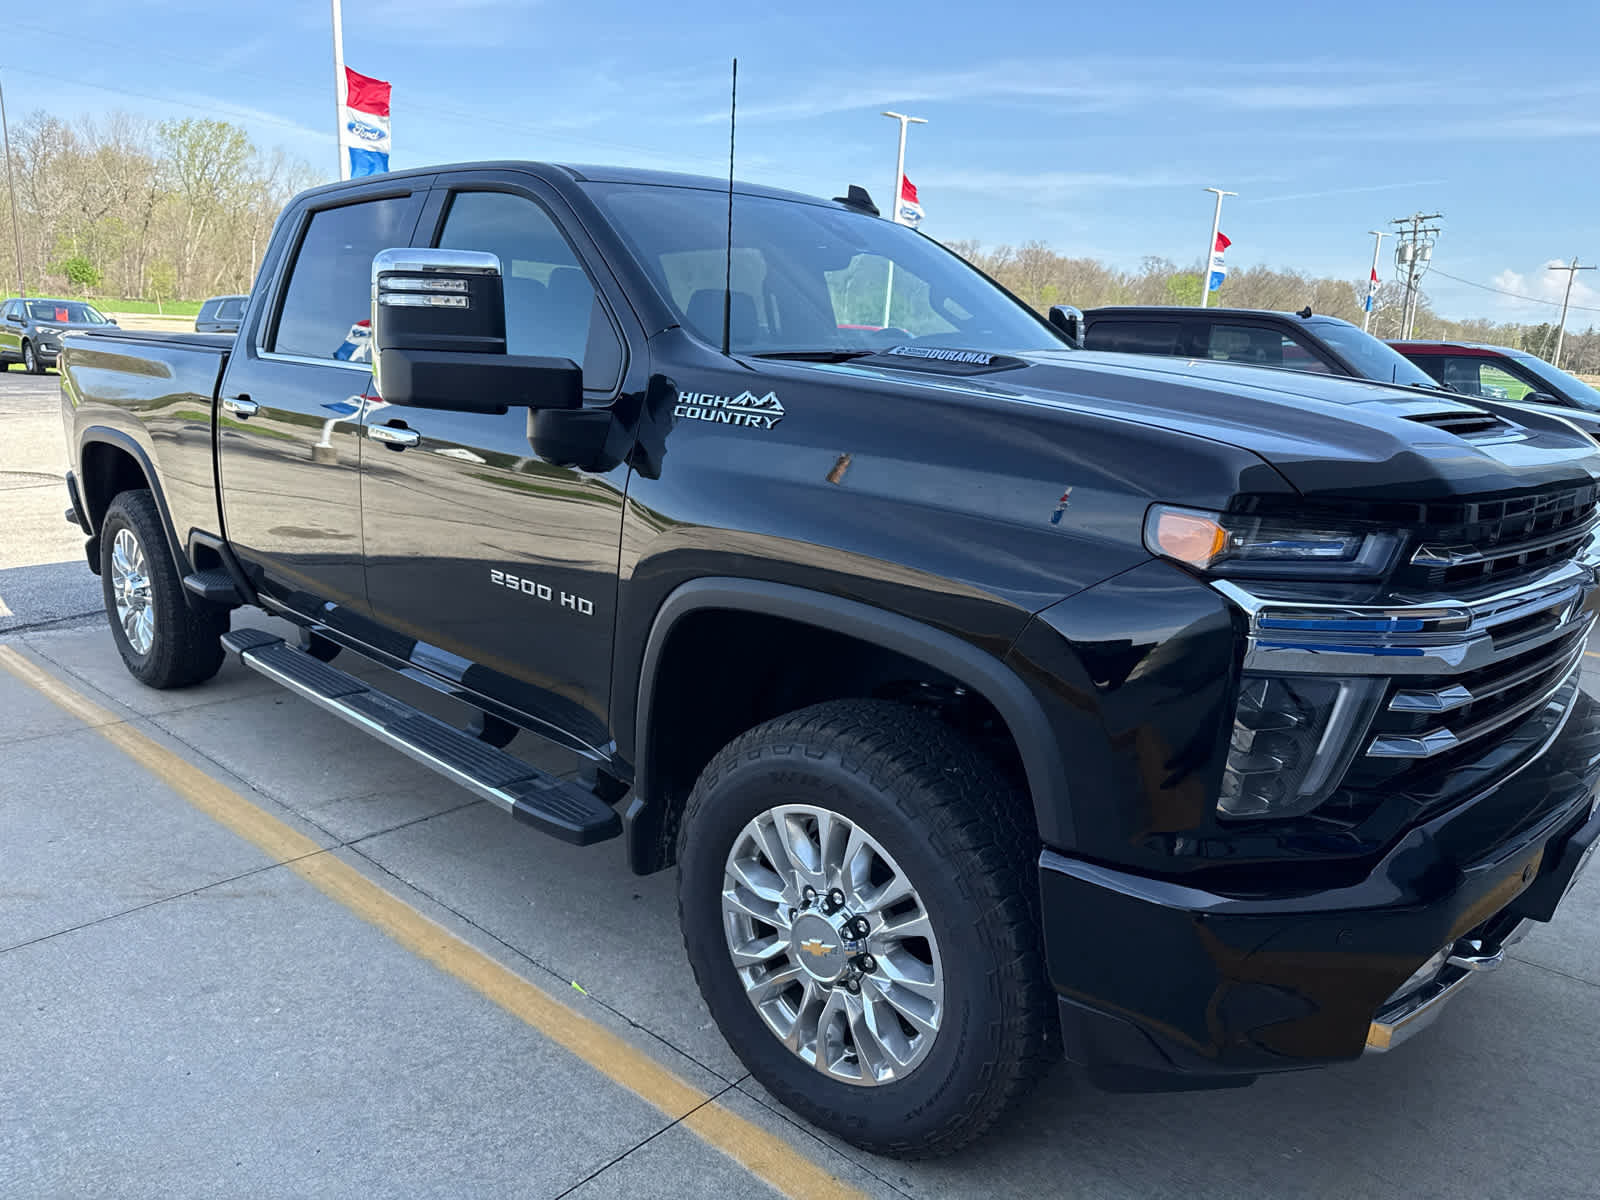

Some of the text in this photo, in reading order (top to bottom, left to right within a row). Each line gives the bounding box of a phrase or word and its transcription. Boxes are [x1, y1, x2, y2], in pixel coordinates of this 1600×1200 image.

[927, 349, 994, 365] DURAMAX
[677, 391, 730, 408] HIGH
[674, 405, 783, 429] COUNTRY
[490, 569, 593, 616] 2500 HD
